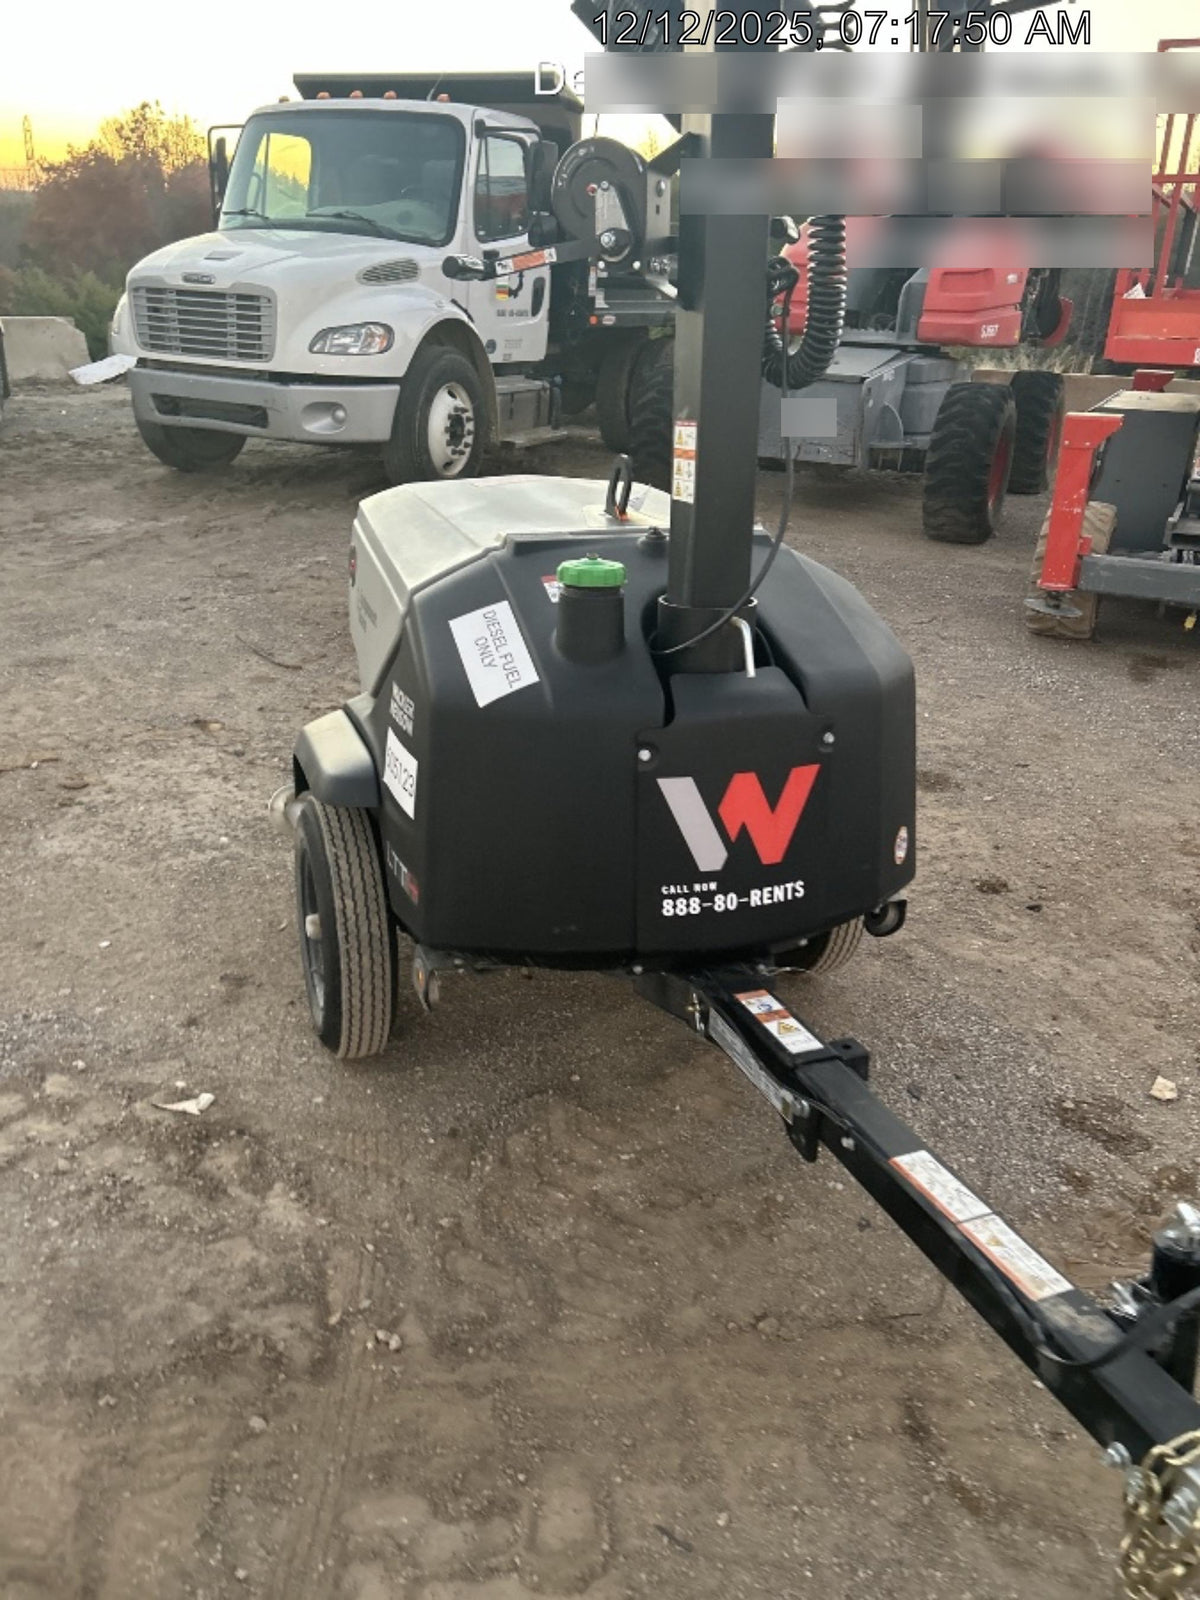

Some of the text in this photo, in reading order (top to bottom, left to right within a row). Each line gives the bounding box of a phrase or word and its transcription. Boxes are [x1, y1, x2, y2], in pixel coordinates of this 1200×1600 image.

[474, 636, 498, 668] ONLY
[482, 609, 521, 689] DIESEL FUEL
[661, 881, 718, 895] CALL NOW
[662, 880, 805, 917] 888-80-RENTS
